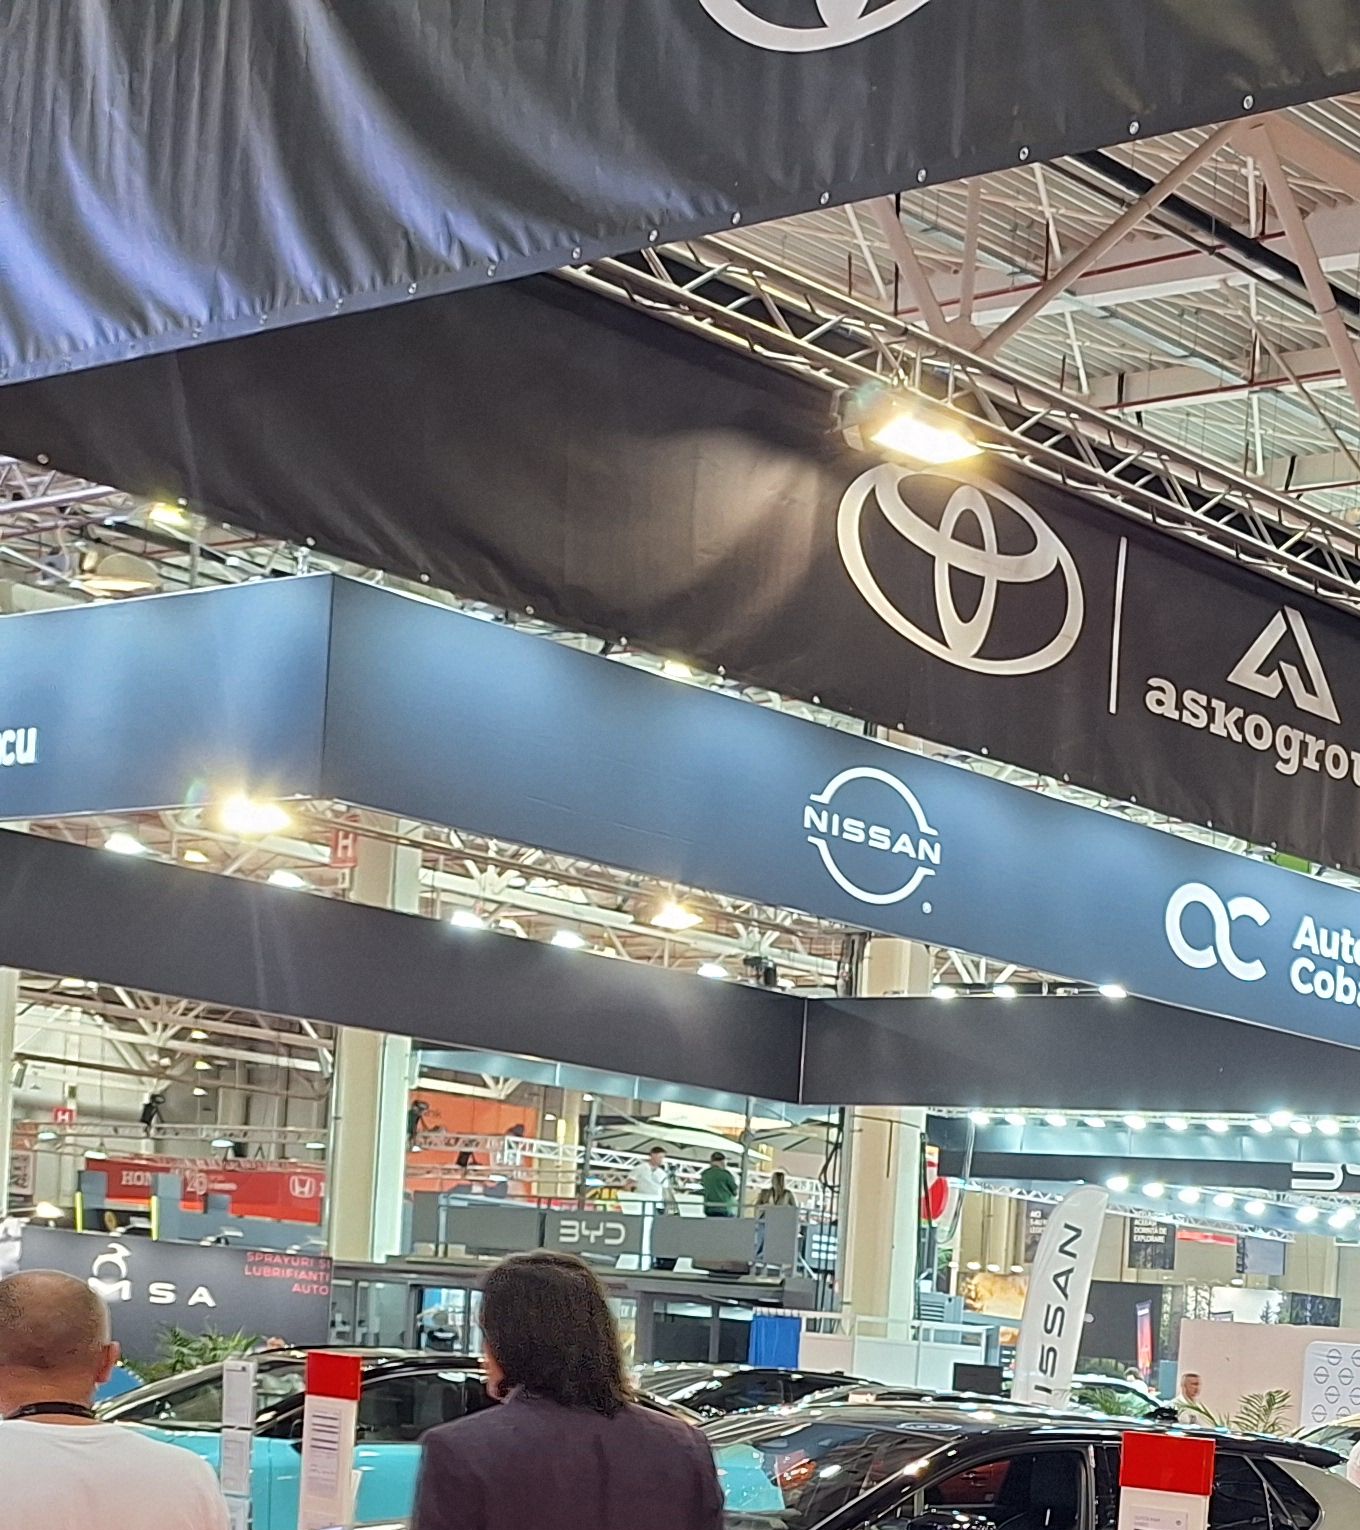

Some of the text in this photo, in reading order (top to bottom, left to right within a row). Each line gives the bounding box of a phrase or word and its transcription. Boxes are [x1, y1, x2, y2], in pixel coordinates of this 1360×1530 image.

[803, 806, 942, 865] NISSAN
[559, 1220, 626, 1246] BYD
[246, 1252, 313, 1266] SPRAYURI
[292, 1283, 328, 1295] AUTO
[1034, 1222, 1083, 1395] ISSAN
